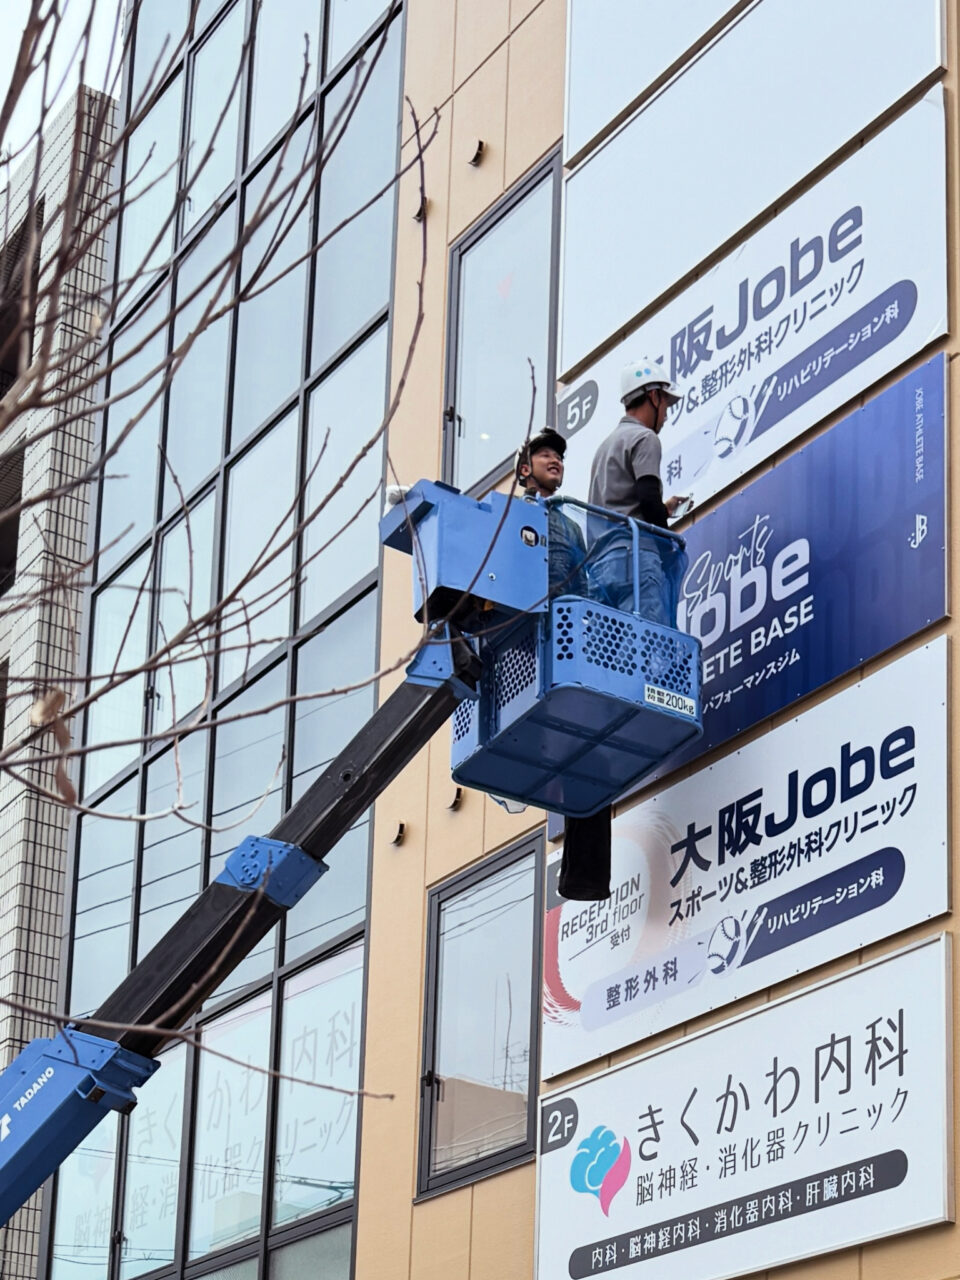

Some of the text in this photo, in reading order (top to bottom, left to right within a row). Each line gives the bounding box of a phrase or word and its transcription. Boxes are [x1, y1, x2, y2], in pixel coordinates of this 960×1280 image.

[643, 205, 863, 382] 阪Jobe
[776, 299, 900, 401] リハビリテーション科
[566, 396, 593, 430] 5F
[750, 595, 815, 656] BASE
[669, 724, 916, 888] 大阪Jobe
[668, 782, 918, 927] スポーツ&整形外科クリニック
[560, 873, 641, 942] RECEPTION
[585, 892, 645, 944] 3rd floor
[767, 866, 885, 934] リハビリテーション科
[610, 924, 631, 950] 受付
[605, 956, 679, 1011] 整形外科
[12, 1066, 55, 1112] TADANO
[636, 1008, 909, 1162] きくかわ内科
[547, 1110, 574, 1144] 2F
[635, 1087, 909, 1207] 脳神経・消化器クリニック
